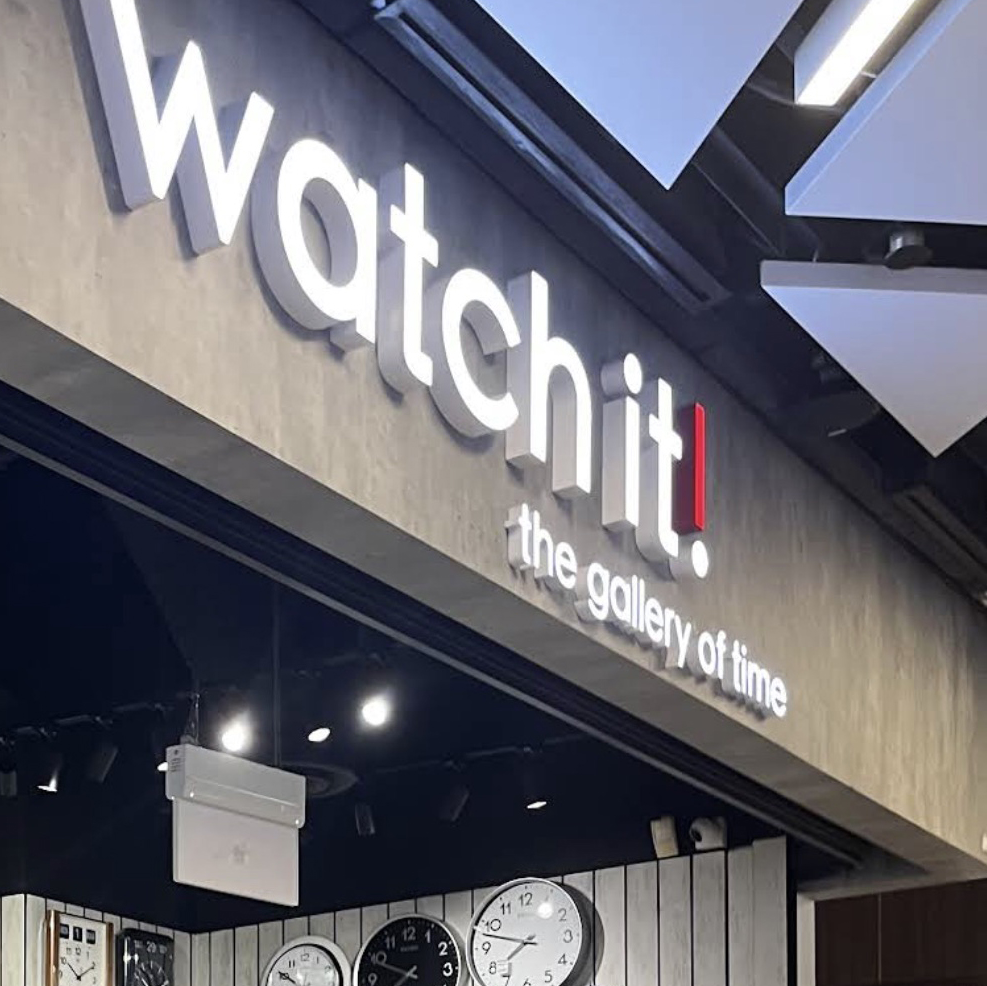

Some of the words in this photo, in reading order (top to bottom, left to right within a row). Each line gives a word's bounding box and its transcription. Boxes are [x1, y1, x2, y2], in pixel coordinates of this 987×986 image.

[110, 0, 592, 495] watch
[622, 353, 710, 578] it!
[518, 503, 577, 589] the
[587, 562, 691, 668] gallery
[698, 630, 726, 679] of
[732, 639, 787, 717] time
[519, 892, 532, 907] 12
[501, 902, 511, 915] 11
[558, 908, 566, 922] 2
[485, 918, 502, 932] 10
[403, 927, 416, 940] 12
[425, 929, 430, 943] 1
[563, 929, 573, 943] 3
[385, 935, 395, 949] 11
[438, 941, 447, 956] 2
[482, 941, 491, 955] 9
[558, 954, 567, 965] 4
[443, 962, 453, 977] 3
[489, 961, 497, 975] 8
[545, 970, 552, 983] 5
